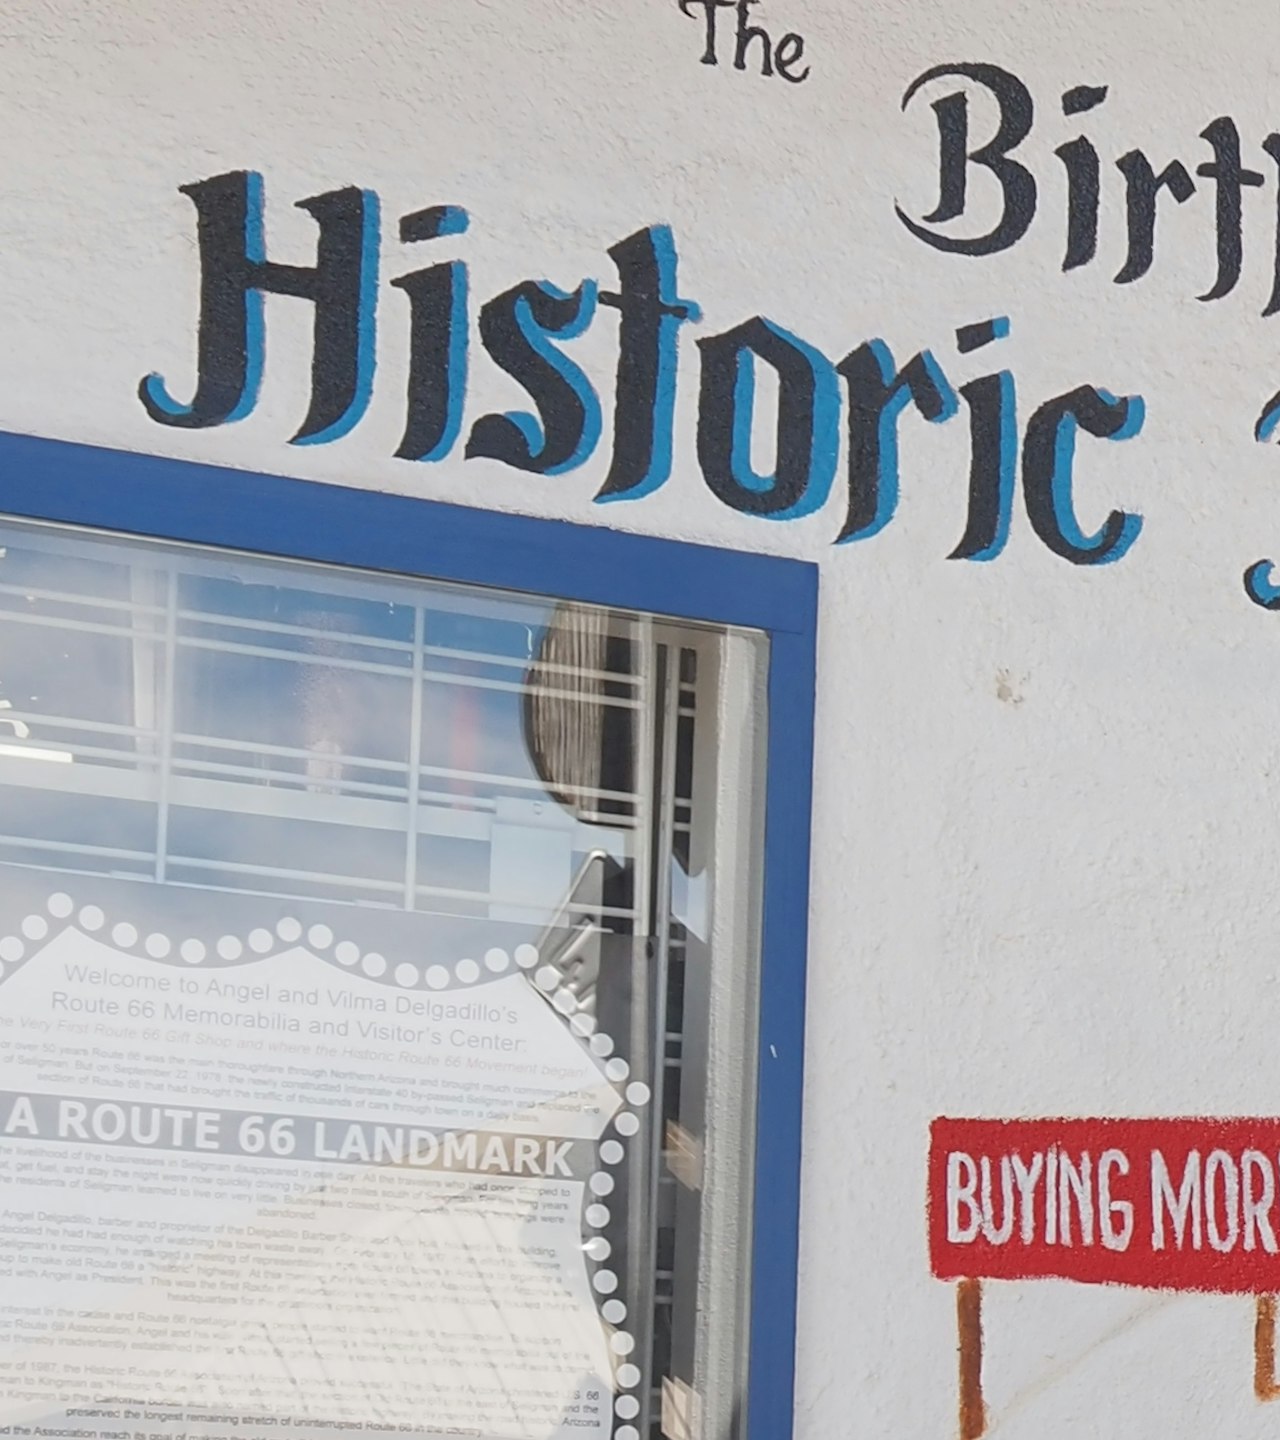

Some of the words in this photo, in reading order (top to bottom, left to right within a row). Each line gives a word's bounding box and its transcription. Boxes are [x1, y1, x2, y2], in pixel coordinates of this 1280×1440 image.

[138, 171, 1145, 563] Historic
[52, 991, 119, 1016] Route
[128, 1000, 155, 1019] 66
[164, 1003, 300, 1033] Memorabilia
[309, 1019, 348, 1038] and
[357, 1020, 442, 1045] Visitor's
[63, 963, 171, 992] Welcome
[180, 976, 199, 995] to
[206, 977, 269, 1004] Angel
[278, 988, 318, 1006] and
[327, 990, 387, 1013] Vilma
[396, 995, 518, 1025] Delgadillo's
[21, 1017, 49, 1032] Very
[57, 1020, 88, 1034] First
[94, 1024, 137, 1039] Route
[143, 1028, 160, 1041] 66
[165, 1029, 190, 1044] Gift
[195, 1032, 230, 1049] Shop
[237, 1038, 262, 1050] and
[316, 1044, 336, 1058] the
[342, 1047, 393, 1063] Historic
[399, 1051, 440, 1066] Route
[444, 1055, 461, 1068] 66
[466, 1057, 536, 1075] Movement
[5, 1096, 39, 1136] A
[58, 1102, 220, 1150] ROUTE
[237, 1115, 297, 1156] 66
[313, 1121, 575, 1178] LANDMARK
[946, 1144, 1134, 1252] BUYING
